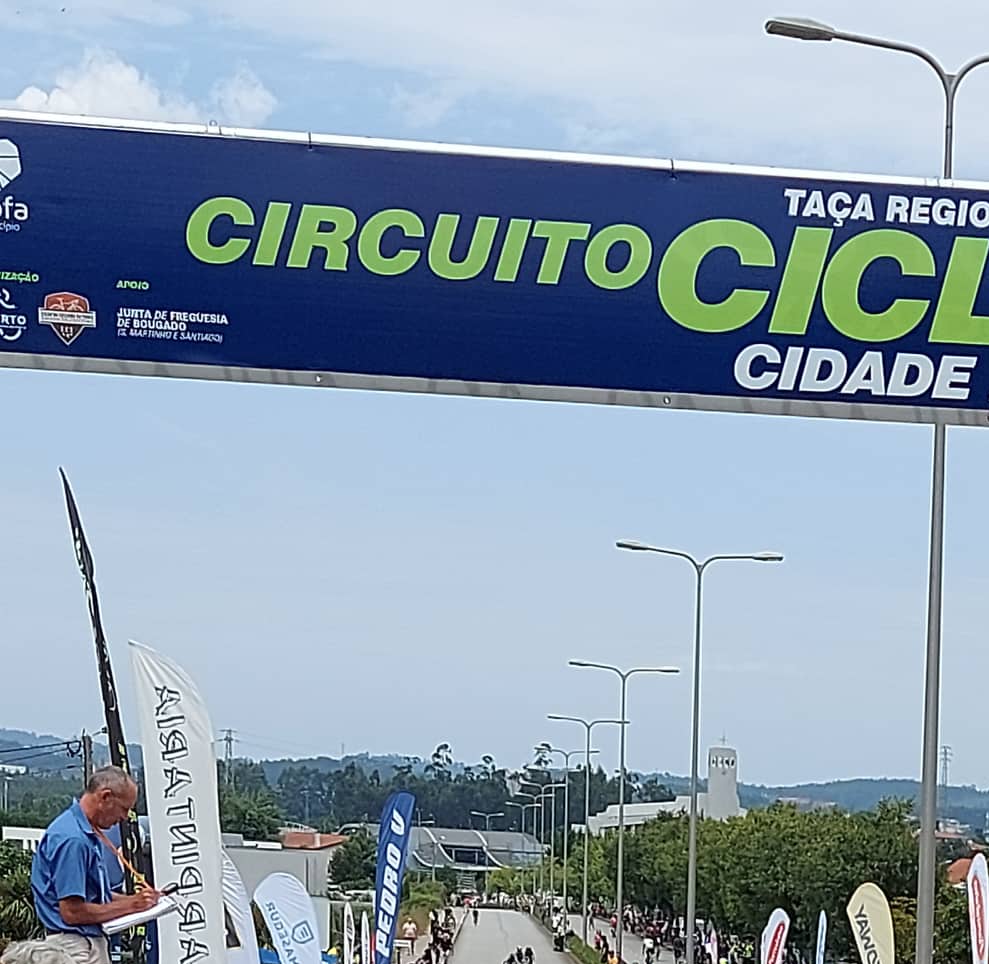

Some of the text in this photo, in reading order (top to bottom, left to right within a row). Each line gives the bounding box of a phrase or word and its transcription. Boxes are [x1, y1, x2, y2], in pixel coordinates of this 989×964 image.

[784, 189, 874, 228] TAÇA
[186, 196, 653, 290] CIRCUITO
[116, 280, 149, 290] APOIO
[117, 308, 229, 325] JUNTA DE FREGUESIA
[117, 318, 187, 331] DE BOUGADO
[734, 343, 978, 399] CIDADE
[376, 843, 402, 958] PEDRO
